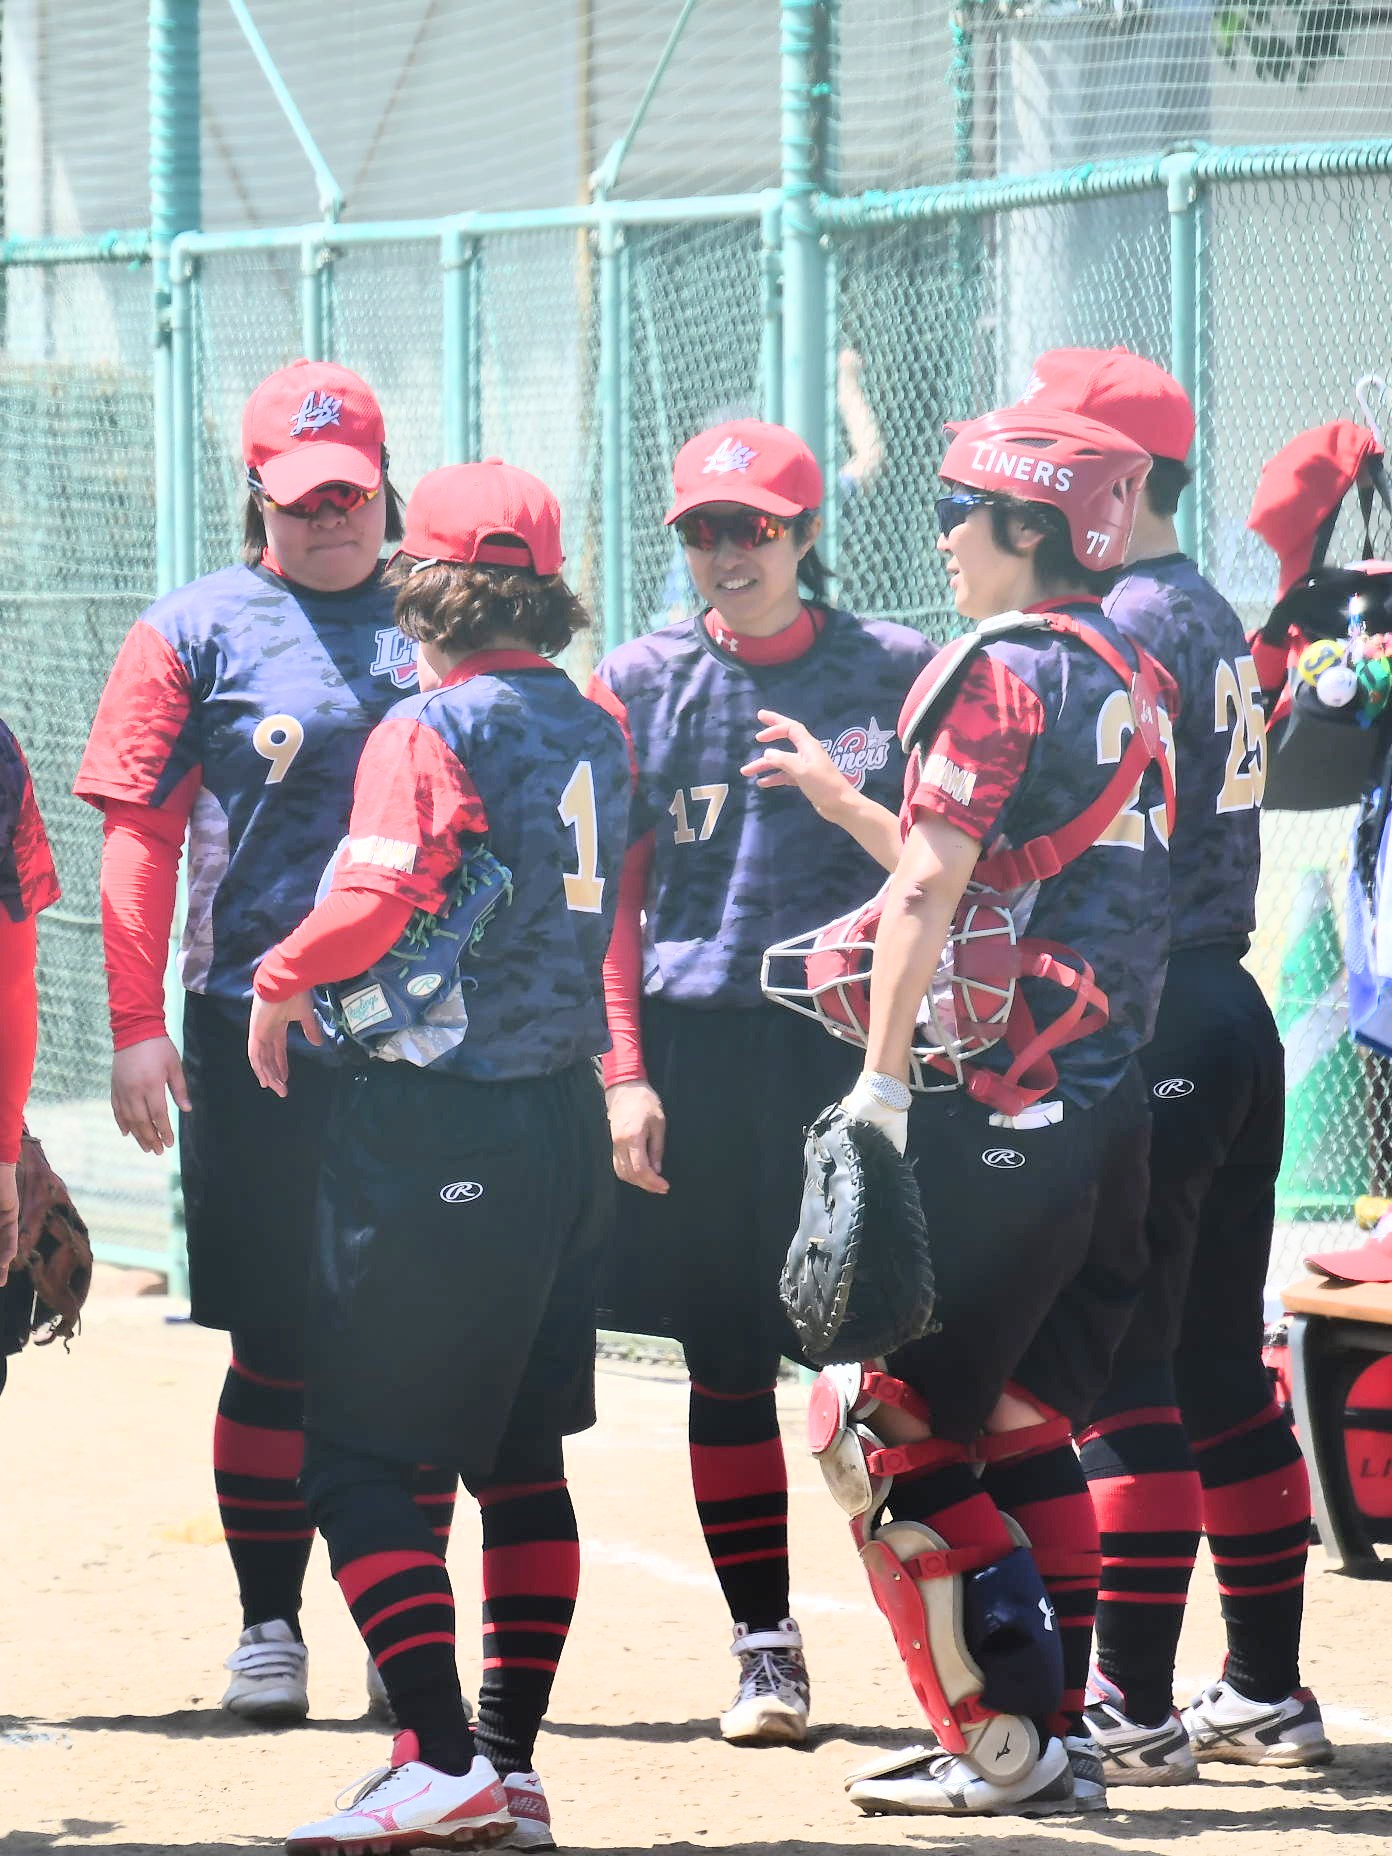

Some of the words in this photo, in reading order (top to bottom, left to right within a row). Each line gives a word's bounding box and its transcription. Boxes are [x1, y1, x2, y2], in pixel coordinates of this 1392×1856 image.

[972, 442, 1074, 492] LINERS
[1086, 530, 1111, 558] 77
[252, 714, 304, 784] 9
[1215, 655, 1268, 814] 25
[557, 760, 606, 914] 1
[669, 784, 729, 845] 17
